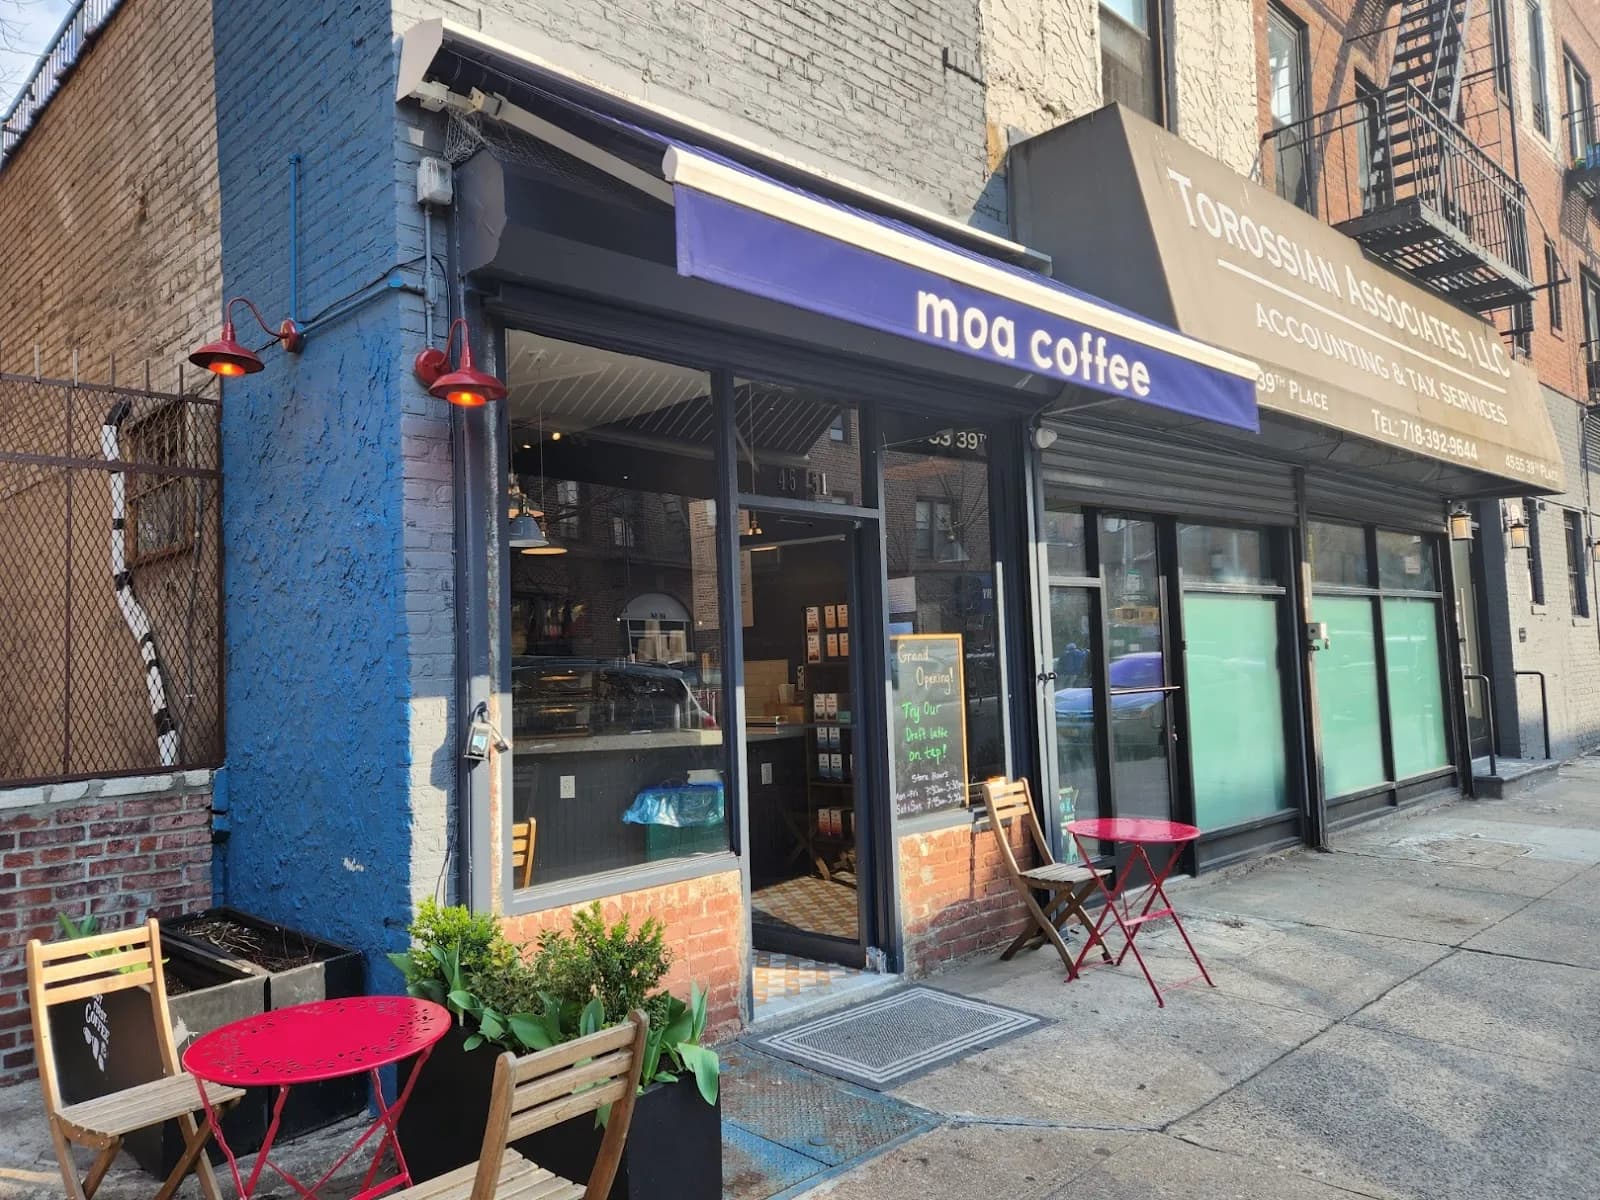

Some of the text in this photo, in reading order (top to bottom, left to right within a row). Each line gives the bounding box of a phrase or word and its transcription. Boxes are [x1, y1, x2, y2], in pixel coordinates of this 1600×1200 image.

[1167, 166, 1511, 378] TOROSSIAN ASSOCIATES, LLC
[917, 290, 1151, 397] moa coffee
[1256, 302, 1508, 425] ACCOUNTING & TAX SERVICES
[1288, 379, 1329, 411] PLACE
[1400, 419, 1479, 460] 718-392-9644
[897, 643, 929, 664] Grand
[916, 666, 954, 696] Opening!
[901, 700, 942, 725] Try Our
[909, 743, 947, 765] on tap!
[85, 1003, 111, 1045] COFFEE
